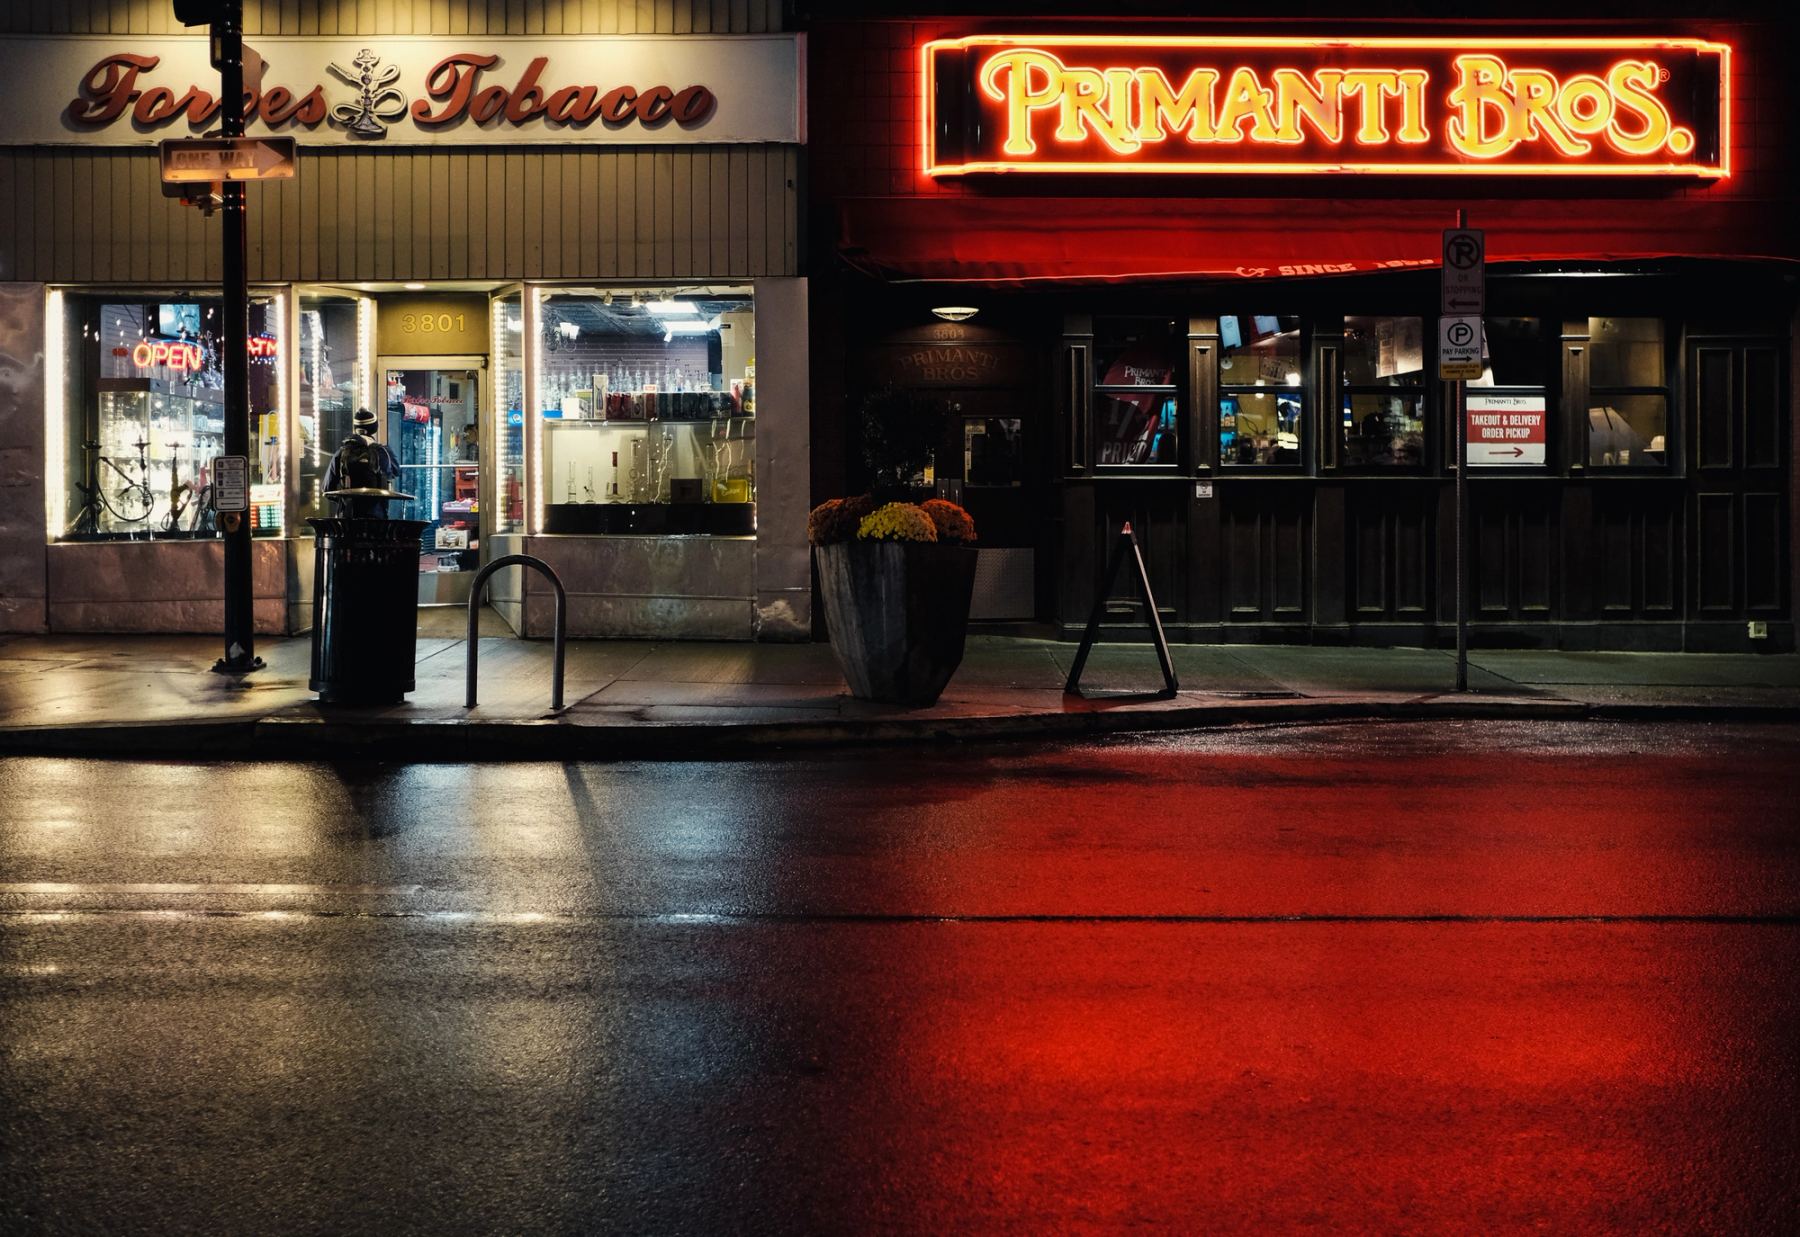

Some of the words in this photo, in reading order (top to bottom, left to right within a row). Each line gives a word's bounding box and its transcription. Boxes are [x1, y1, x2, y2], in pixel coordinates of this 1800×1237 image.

[411, 53, 715, 124] Tobacco
[979, 48, 1431, 157] PRIMANTI
[176, 151, 212, 169] ONE
[218, 150, 256, 168] WAY
[1278, 262, 1357, 277] SINCE
[401, 312, 466, 334] 3801
[132, 343, 203, 370] OPEN
[898, 348, 1001, 370] PRIMANTI
[1454, 347, 1480, 355] PARKING
[1471, 414, 1501, 426] TAKEOUT
[1502, 414, 1509, 425] &
[1509, 414, 1541, 426] DELIVERY
[1481, 427, 1504, 439] ORDER
[1505, 427, 1531, 439] PICKUP
